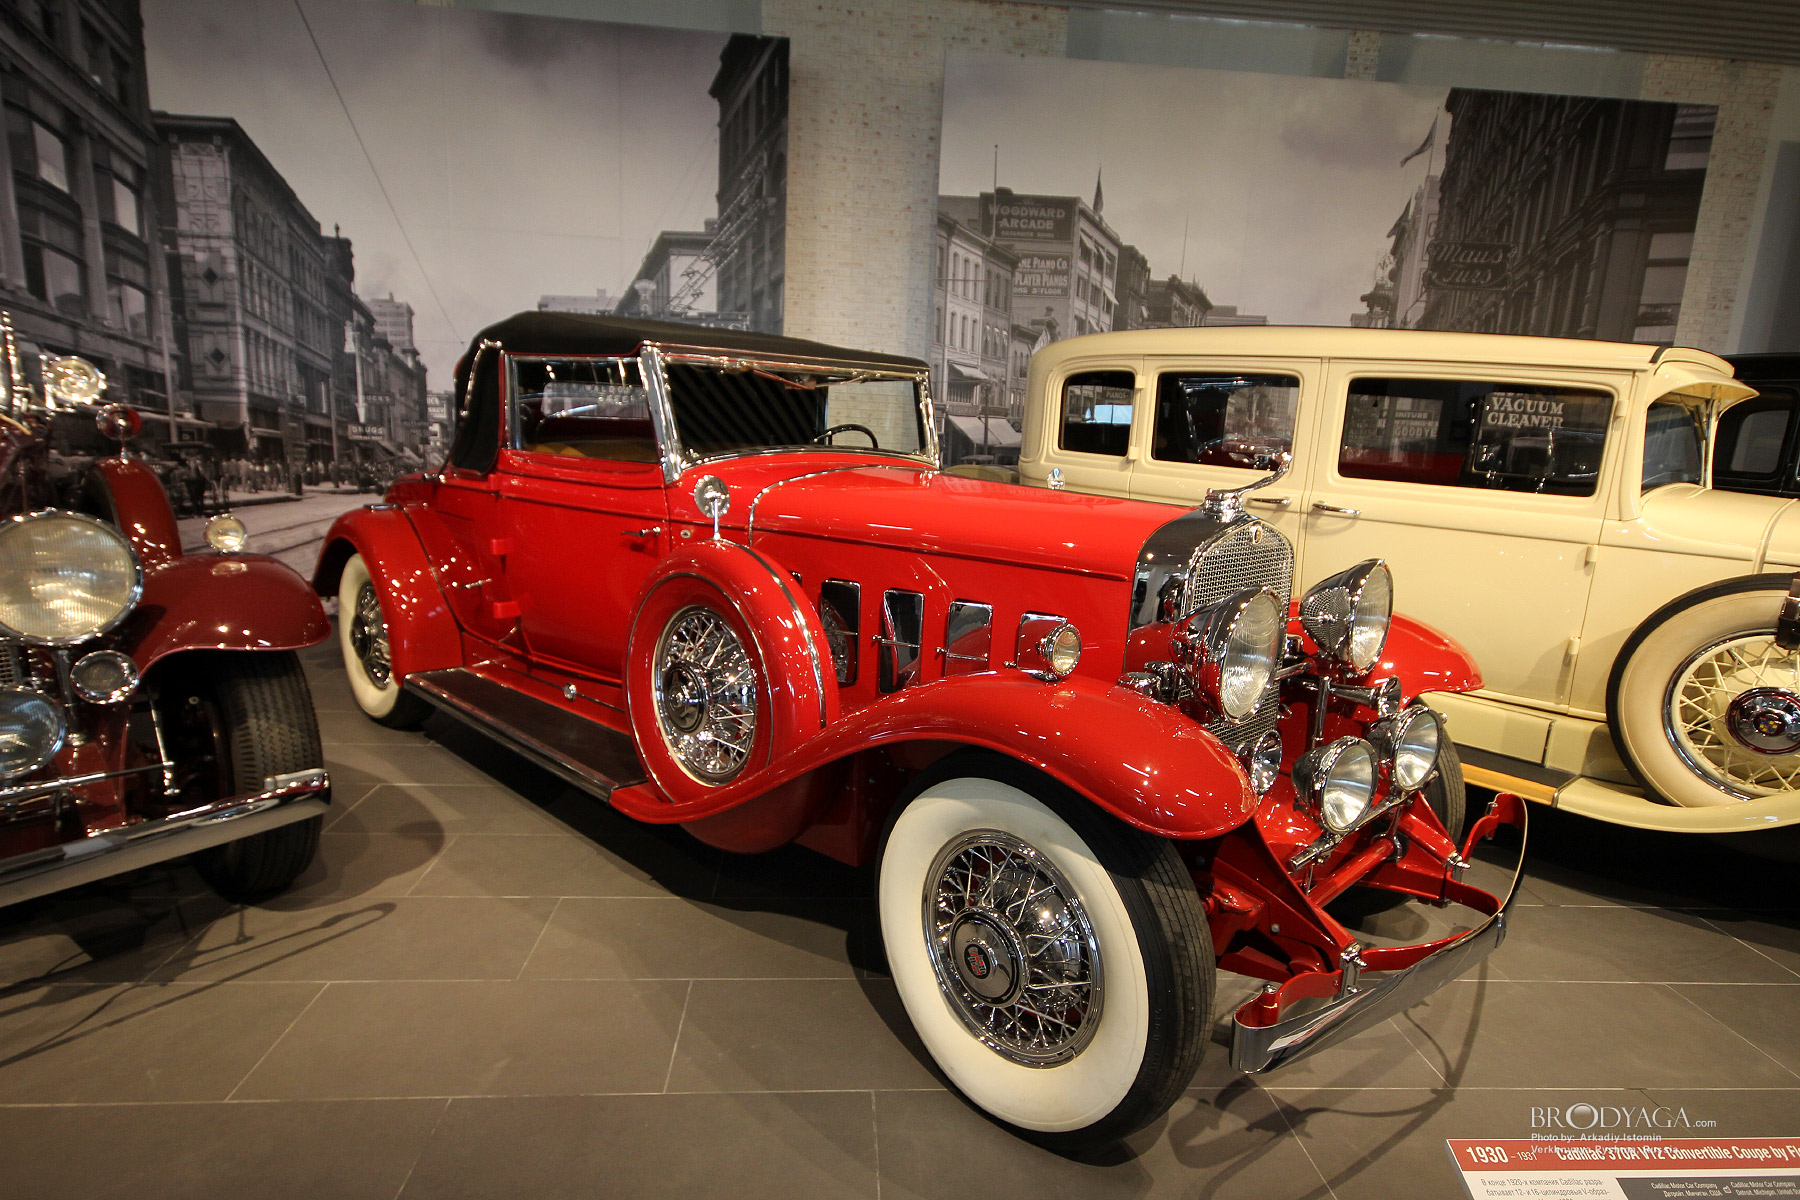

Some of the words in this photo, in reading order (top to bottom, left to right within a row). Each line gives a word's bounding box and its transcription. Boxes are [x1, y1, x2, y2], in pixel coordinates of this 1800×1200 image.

[988, 203, 1066, 219] WOODWARD
[999, 217, 1054, 229] ARCADE
[1014, 272, 1041, 286] PLAYER
[1491, 396, 1565, 415] VACUUM
[1487, 411, 1564, 429] CLEANER
[1466, 1146, 1509, 1164] 1930
[1516, 1151, 1538, 1161] 1931
[1556, 1146, 1605, 1161] Cadillac
[1662, 1145, 1732, 1161] Convertible
[1732, 1145, 1772, 1162] Coupe
[1769, 1145, 1789, 1162] by
